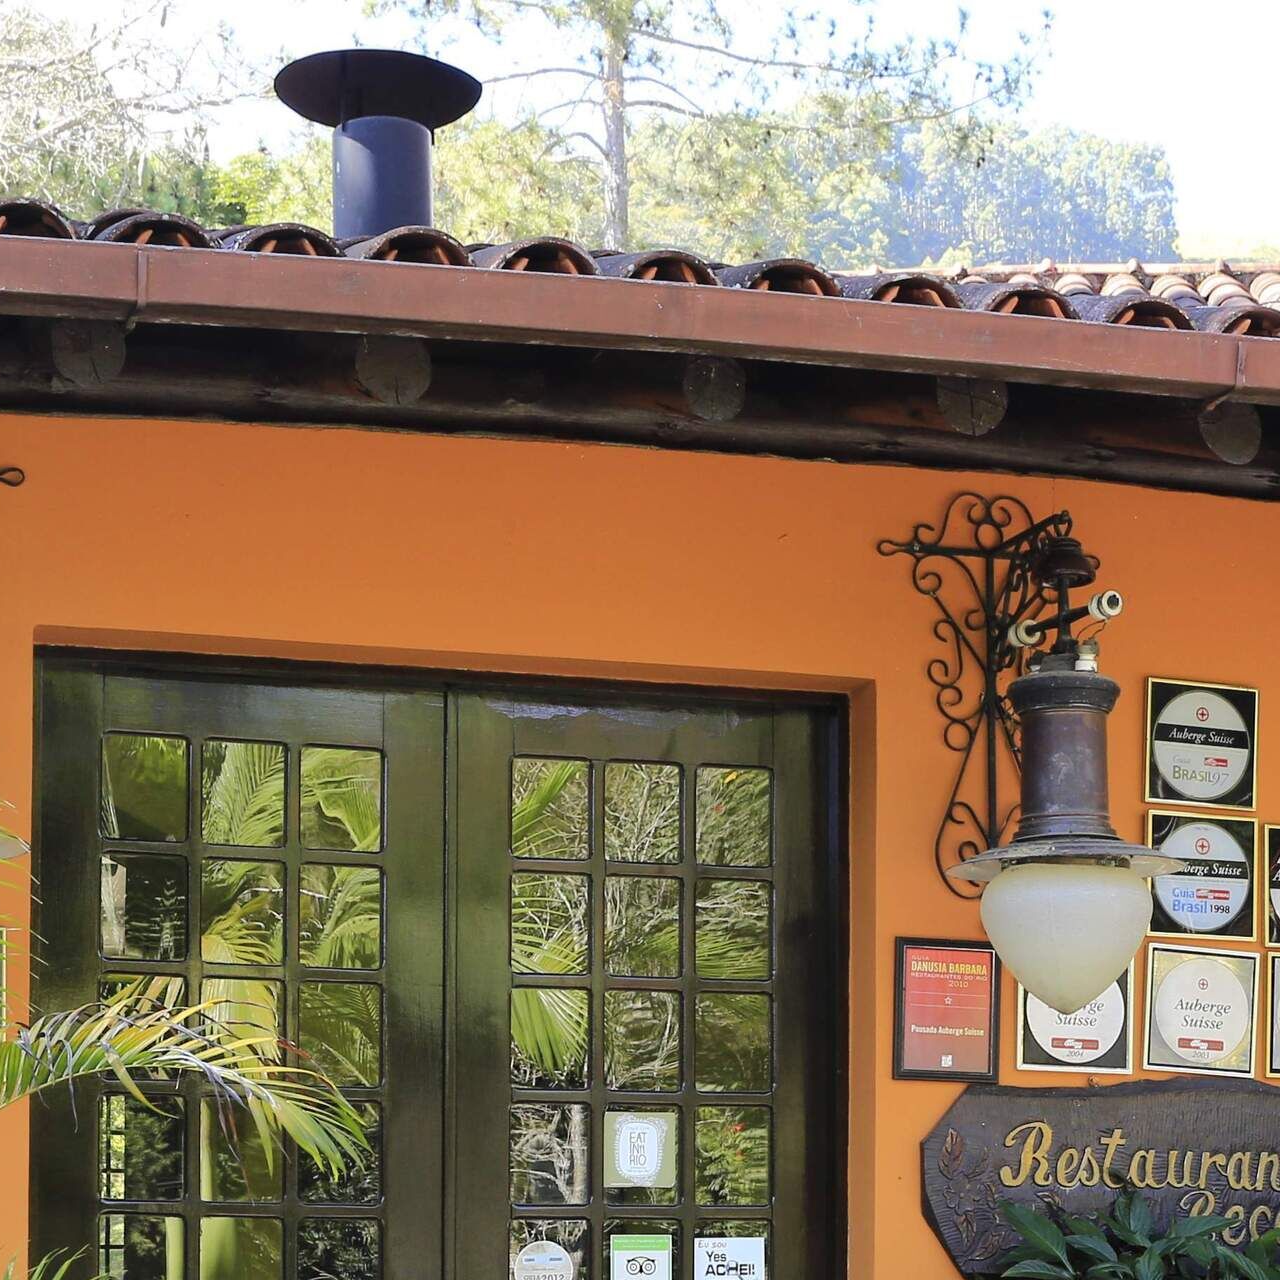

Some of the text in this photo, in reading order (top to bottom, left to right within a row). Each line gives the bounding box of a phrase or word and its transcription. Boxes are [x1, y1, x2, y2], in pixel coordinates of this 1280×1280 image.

[1169, 728, 1235, 744] Auberge Suisse
[1181, 861, 1242, 876] berge Suisse
[1172, 887, 1195, 898] Guia
[1172, 900, 1231, 914] Brasil 1998
[911, 961, 987, 975] DANUSIA BARBARA
[1174, 998, 1232, 1017] Auberge
[1055, 1013, 1097, 1027] Suisse
[1181, 1015, 1224, 1030] Suisse
[938, 1026, 964, 1037] Auberge
[964, 1027, 985, 1037] Suisse
[629, 1131, 648, 1144] EAT
[705, 1250, 727, 1262] Yes
[705, 1262, 755, 1276] ACHEI!
